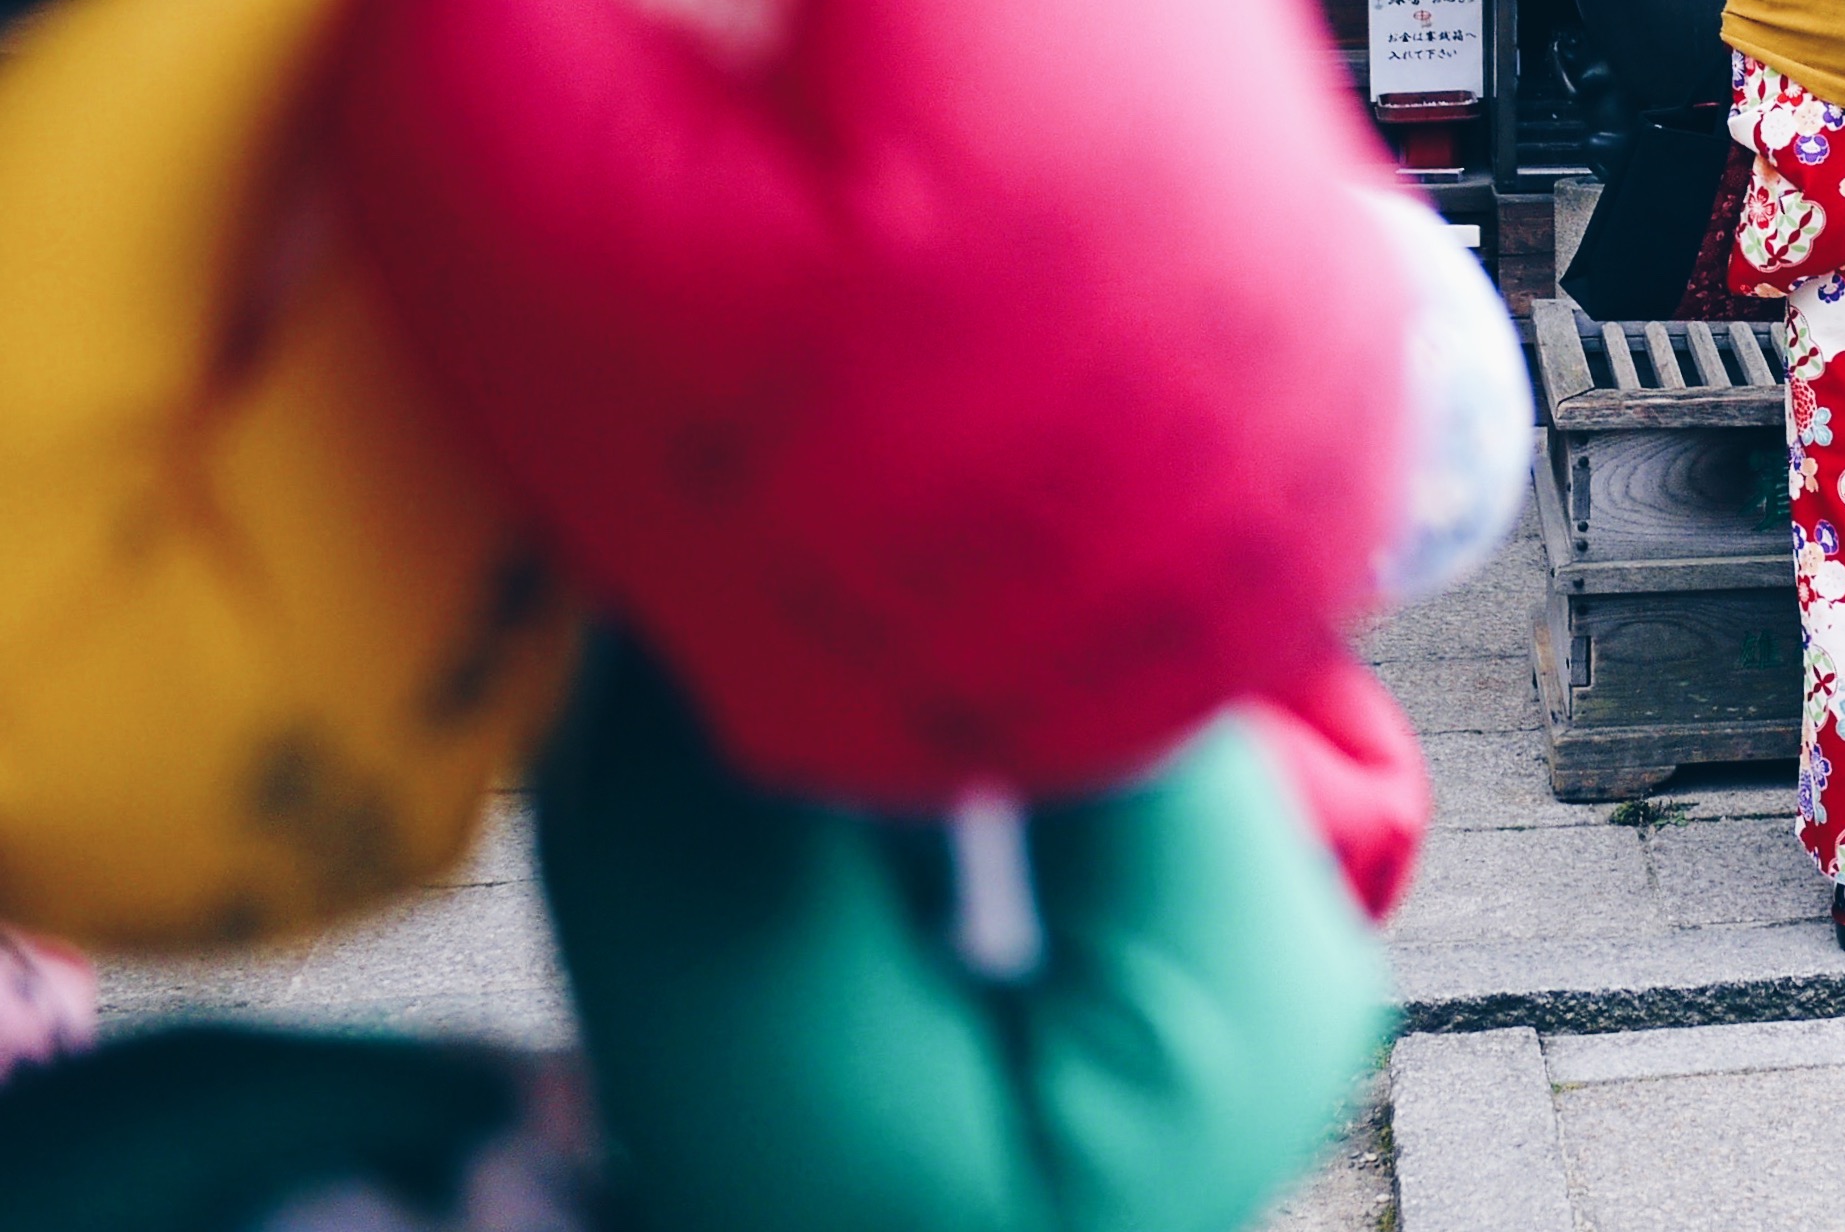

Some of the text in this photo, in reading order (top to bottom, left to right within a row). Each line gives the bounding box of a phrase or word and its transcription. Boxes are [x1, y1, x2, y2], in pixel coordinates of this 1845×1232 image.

[1388, 48, 1457, 60] 入れて下さい
